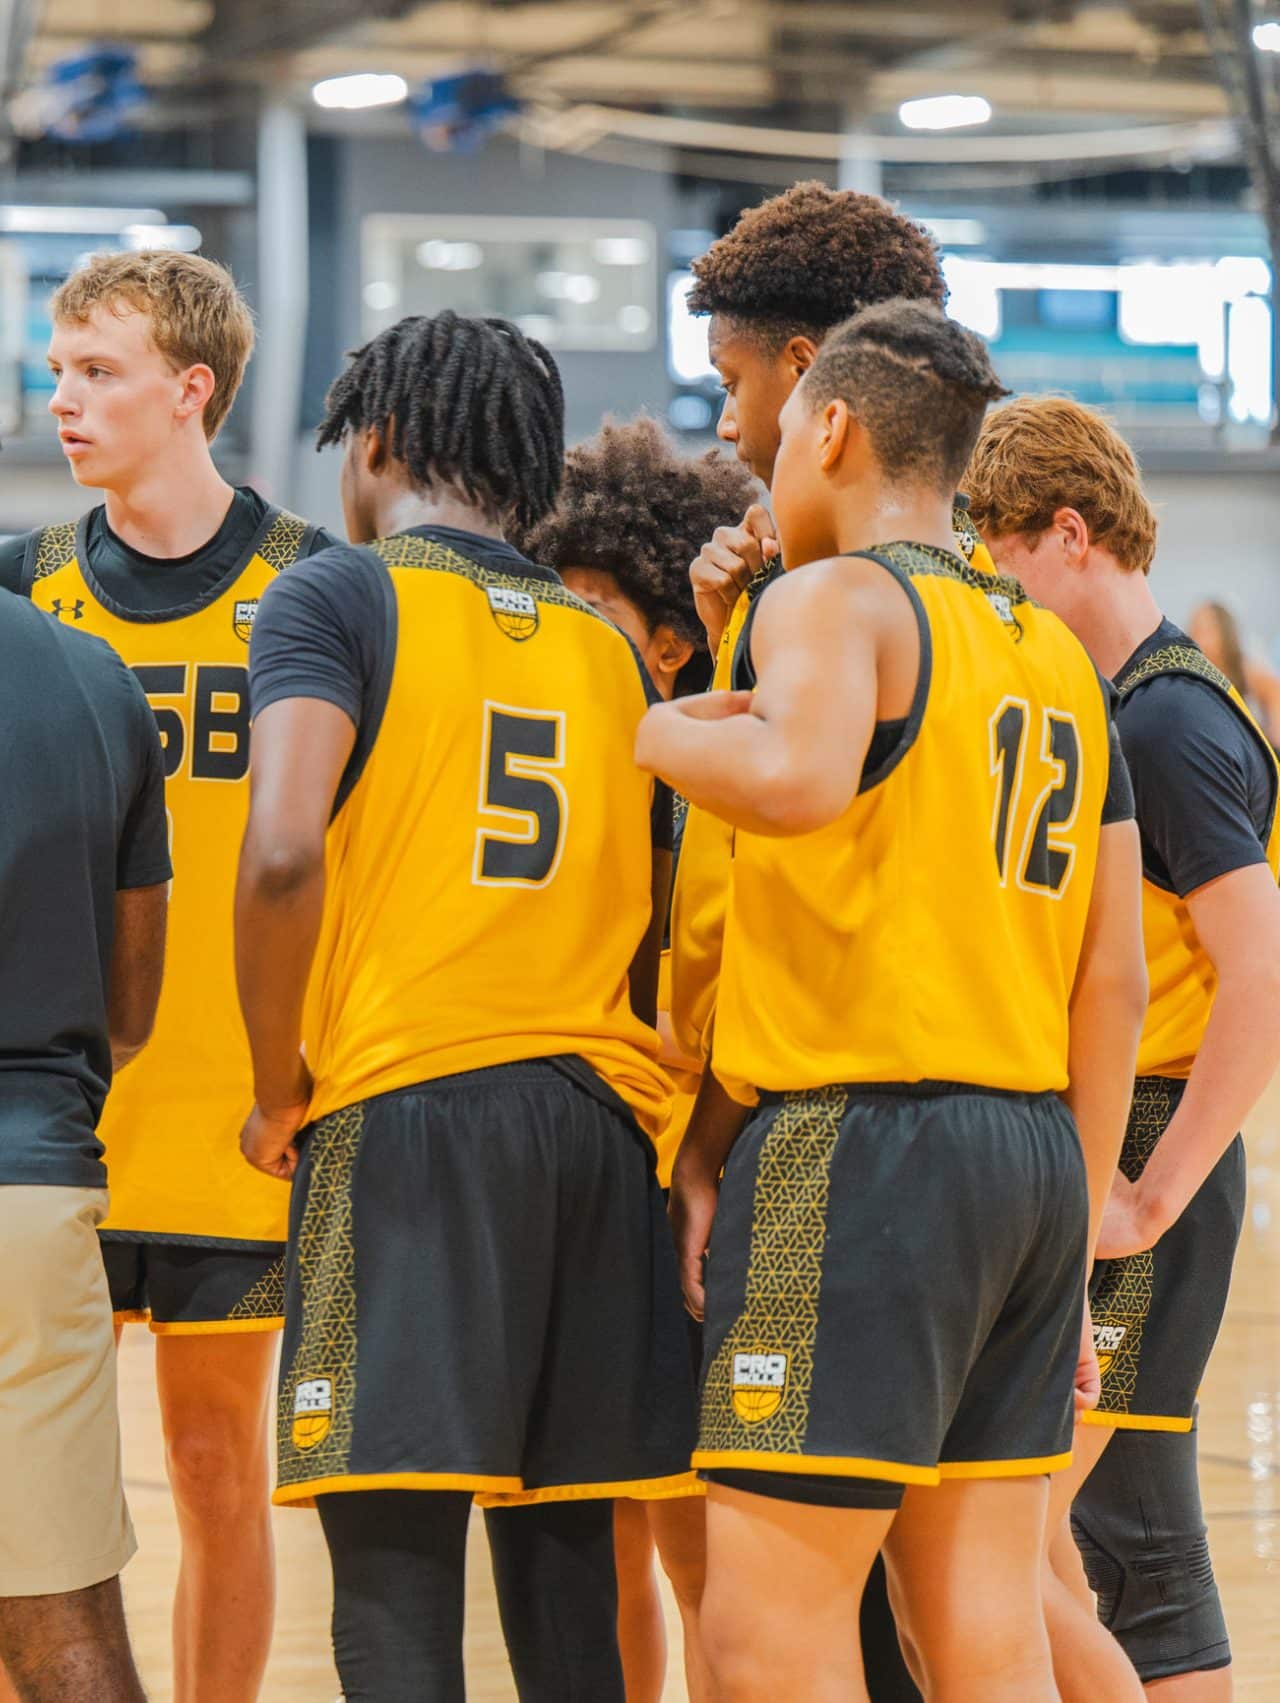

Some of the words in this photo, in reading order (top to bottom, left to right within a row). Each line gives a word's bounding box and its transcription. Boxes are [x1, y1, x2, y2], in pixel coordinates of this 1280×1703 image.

[486, 586, 534, 606] PRO
[471, 699, 569, 890] 5
[988, 695, 1083, 900] 12
[734, 1353, 787, 1374] PRO
[733, 1372, 785, 1386] SKILLS
